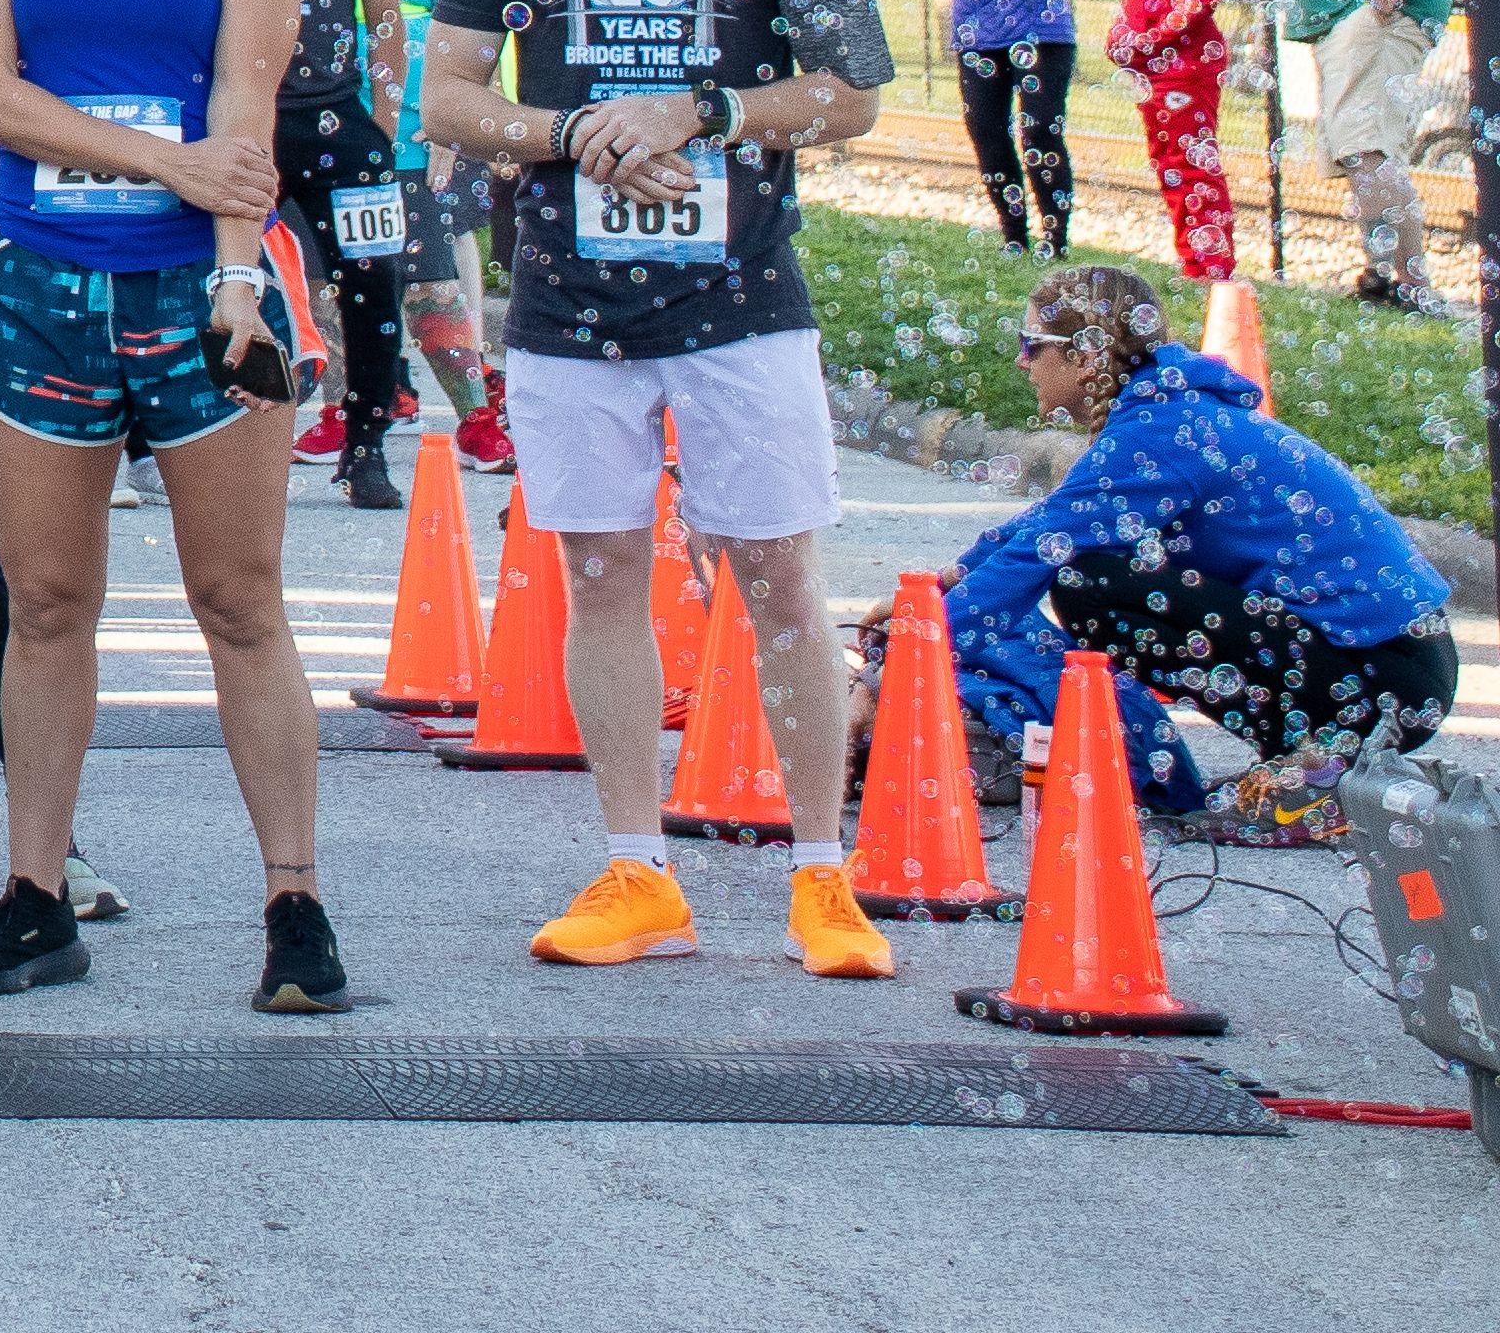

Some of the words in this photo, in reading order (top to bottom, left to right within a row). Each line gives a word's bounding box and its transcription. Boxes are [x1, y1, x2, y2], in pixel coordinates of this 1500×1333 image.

[599, 17, 683, 39] YEARS
[564, 44, 636, 65] BRIDGE
[638, 45, 680, 65] THE
[682, 45, 722, 66] GAP
[600, 67, 612, 78] TO
[616, 67, 654, 78] HEALTH
[659, 67, 685, 79] RACE
[92, 105, 114, 119] THE
[115, 105, 140, 119] GAP
